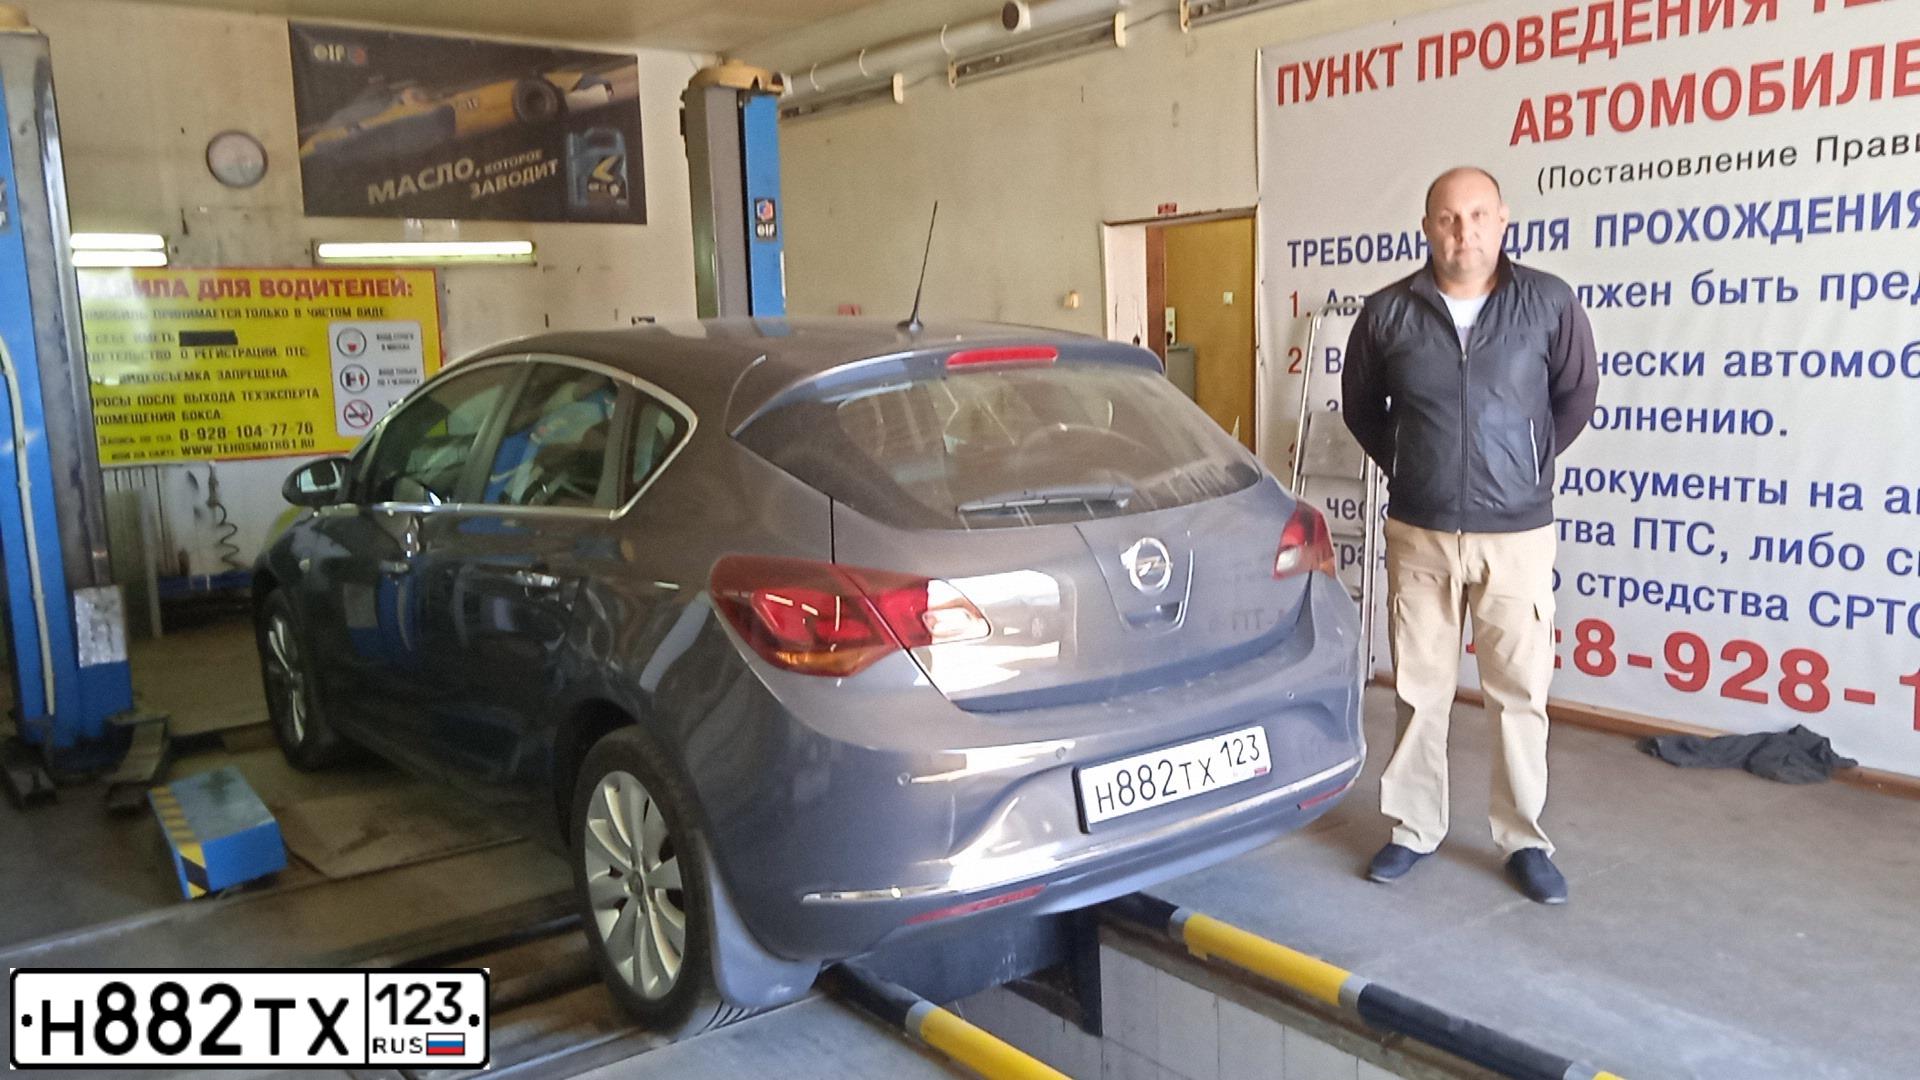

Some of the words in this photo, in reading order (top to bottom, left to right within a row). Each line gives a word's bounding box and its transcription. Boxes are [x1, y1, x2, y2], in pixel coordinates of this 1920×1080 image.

[1277, 42, 1403, 106] ПУНКТ
[1510, 38, 1920, 146] АВТОМОБИЛЕ
[368, 157, 481, 206] МАСЛО,
[484, 149, 543, 176] КОТОРОЕ
[469, 158, 558, 199] ЗАВОДИТ
[1537, 145, 1798, 195] (Постановление
[1815, 133, 1920, 167] Прав
[1287, 230, 1431, 268] ТРЕБОВАН
[1502, 217, 1570, 261] ДЛЯ
[198, 277, 251, 302] ДЛЯ
[259, 277, 413, 301] ВОДИТЕЛЕЙ:
[246, 306, 288, 319] ТОЛЬКО
[307, 306, 352, 318] ЧИСТОМ
[1289, 290, 1311, 318] 1.
[1576, 281, 1672, 308] лжен
[1691, 269, 1799, 305] быть
[137, 393, 176, 406] ПОСЛЕ
[183, 390, 236, 404] ВЫХОДА
[1588, 404, 1788, 437] олнению.
[1559, 466, 1788, 506] документы
[1809, 480, 1864, 511] на
[1554, 517, 1616, 547] тва
[1633, 517, 1729, 564] ПТС,
[1748, 532, 1865, 571] либо
[1576, 571, 1789, 621] стредства
[1095, 757, 1216, 814] Н882ТХ
[1220, 734, 1260, 768] 123
